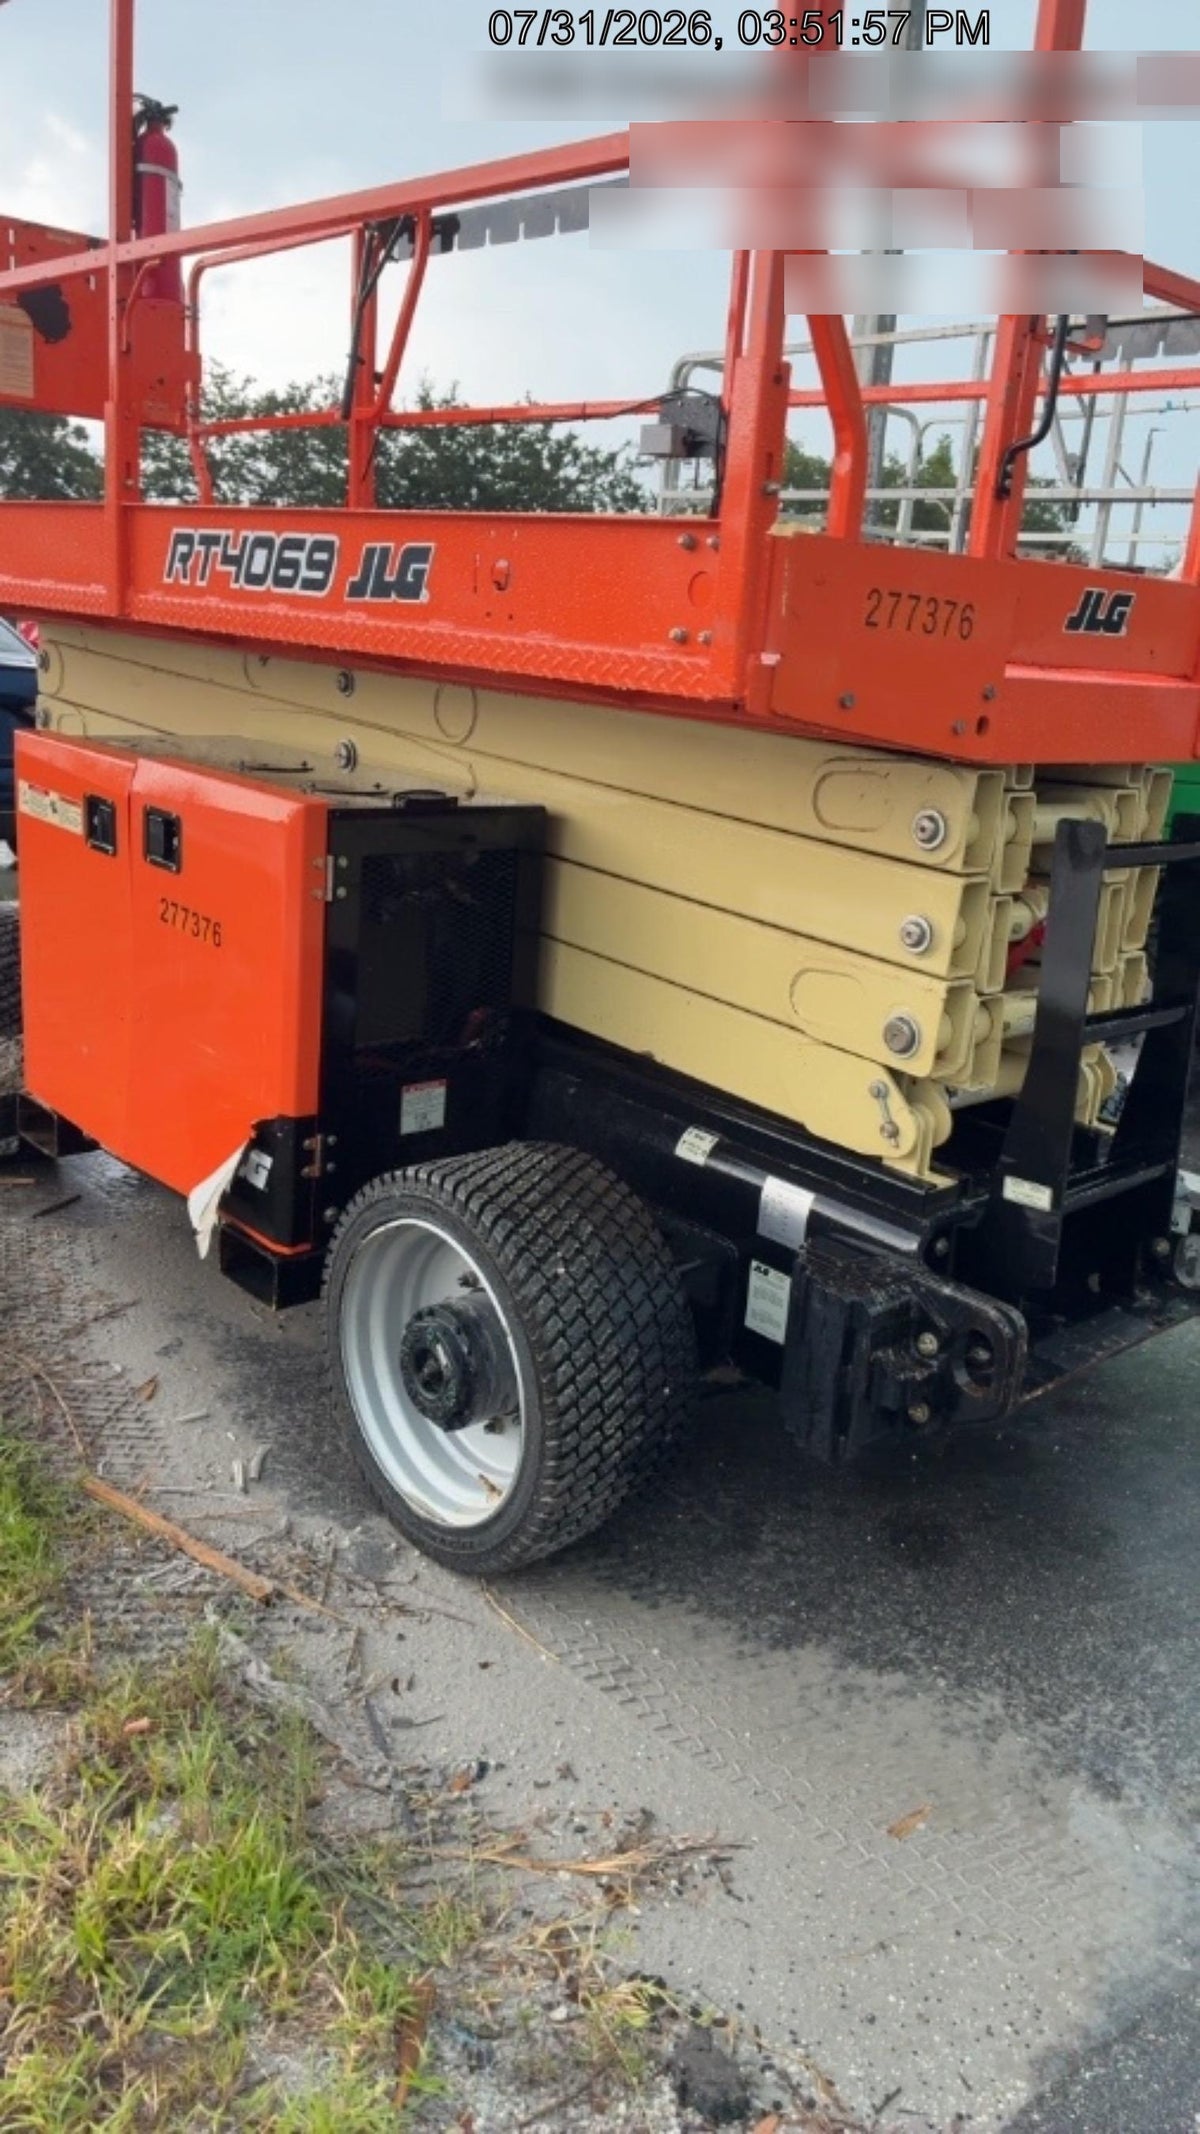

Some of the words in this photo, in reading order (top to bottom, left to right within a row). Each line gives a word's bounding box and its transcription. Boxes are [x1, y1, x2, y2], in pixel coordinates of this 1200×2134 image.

[163, 528, 340, 598] RT4069
[344, 543, 436, 604] JLG
[864, 587, 976, 641] 277376
[1063, 587, 1136, 637] JLG
[160, 897, 222, 948] 277376
